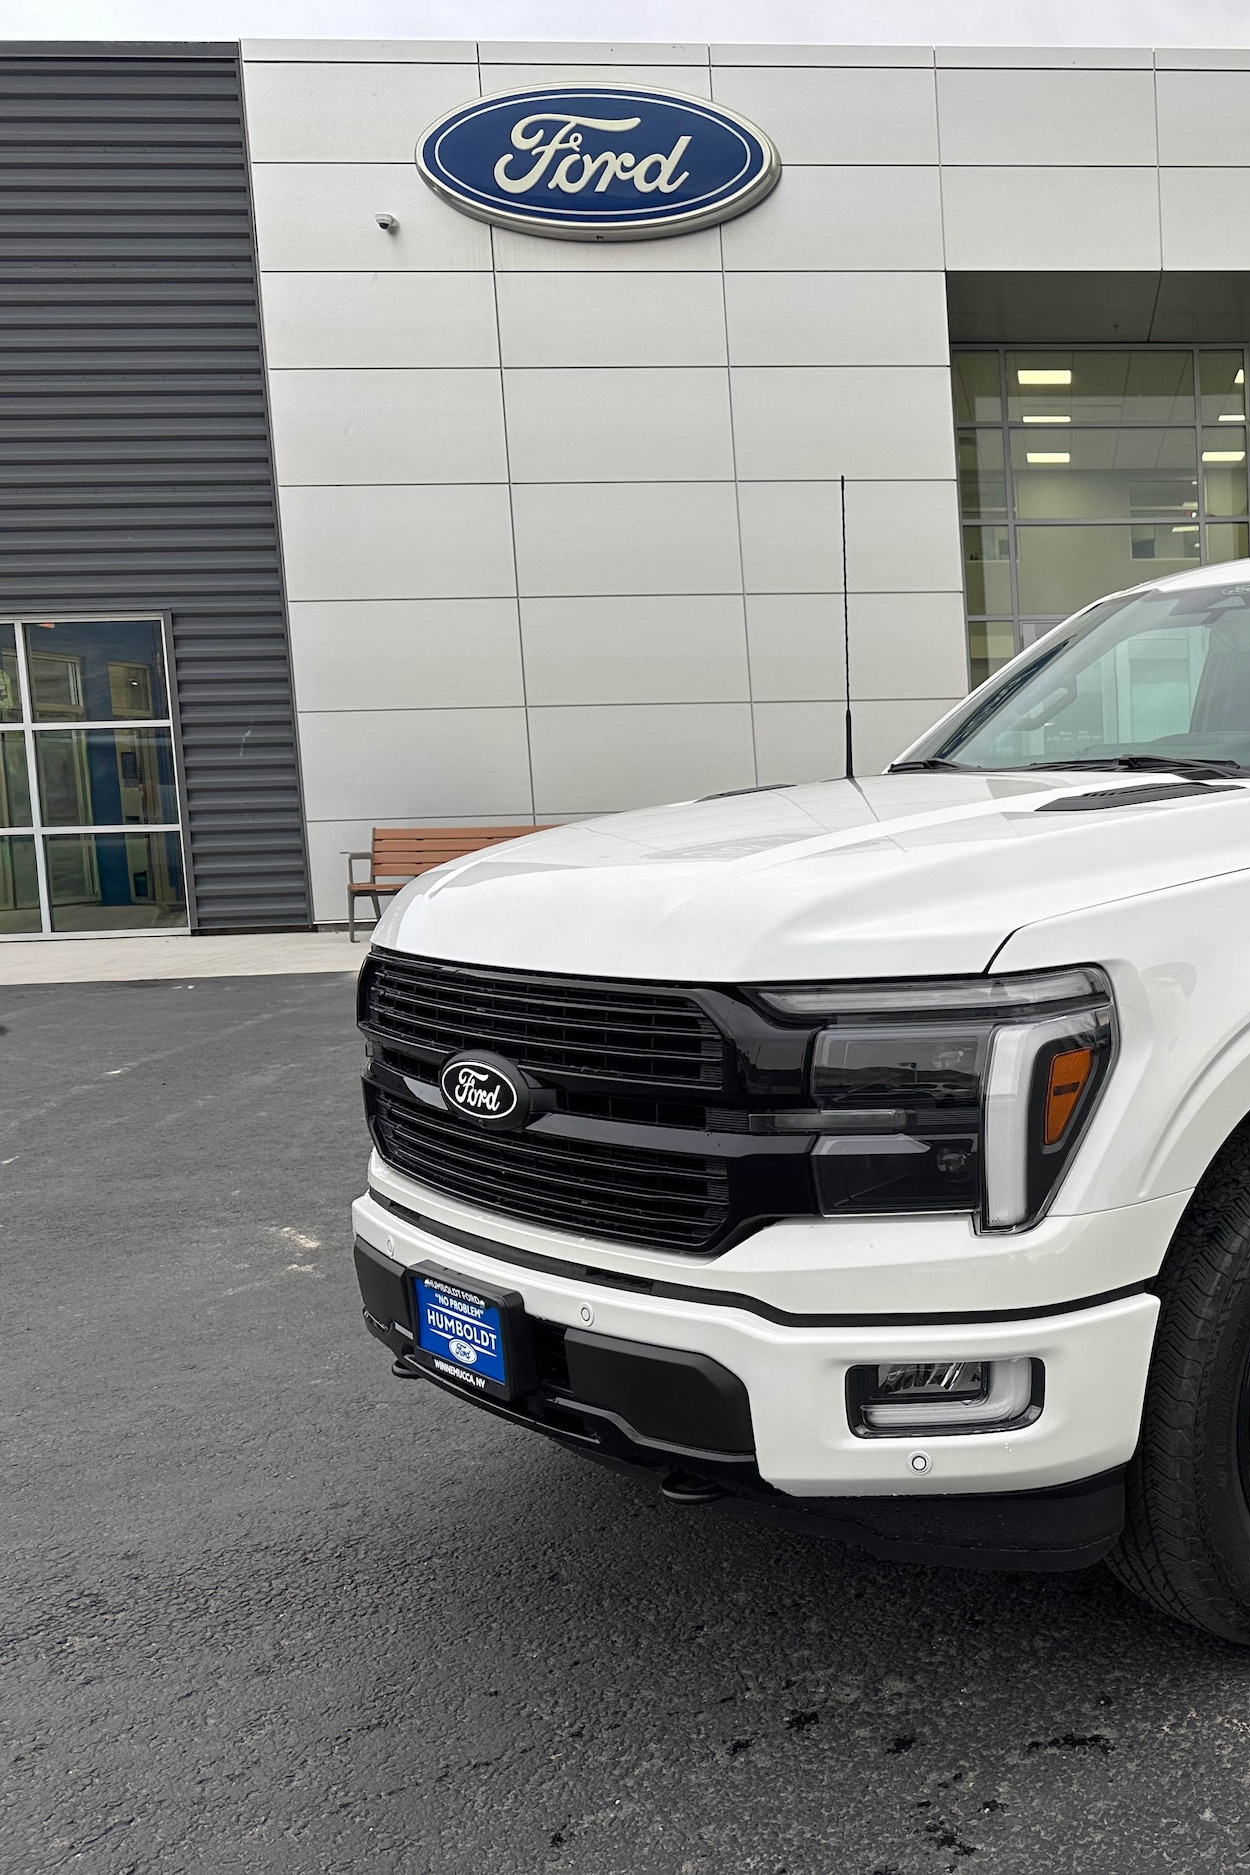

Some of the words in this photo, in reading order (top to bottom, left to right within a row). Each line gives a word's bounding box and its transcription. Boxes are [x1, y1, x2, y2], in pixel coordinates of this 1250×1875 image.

[494, 113, 692, 194] Ford
[455, 1068, 500, 1111] Ford
[429, 1280, 462, 1298] HUMBOLDT
[461, 1291, 480, 1305] FORD
[426, 1309, 497, 1350] HUMBOLDT
[456, 1342, 471, 1360] Ford
[434, 1359, 476, 1386] WINNEMUCCA,
